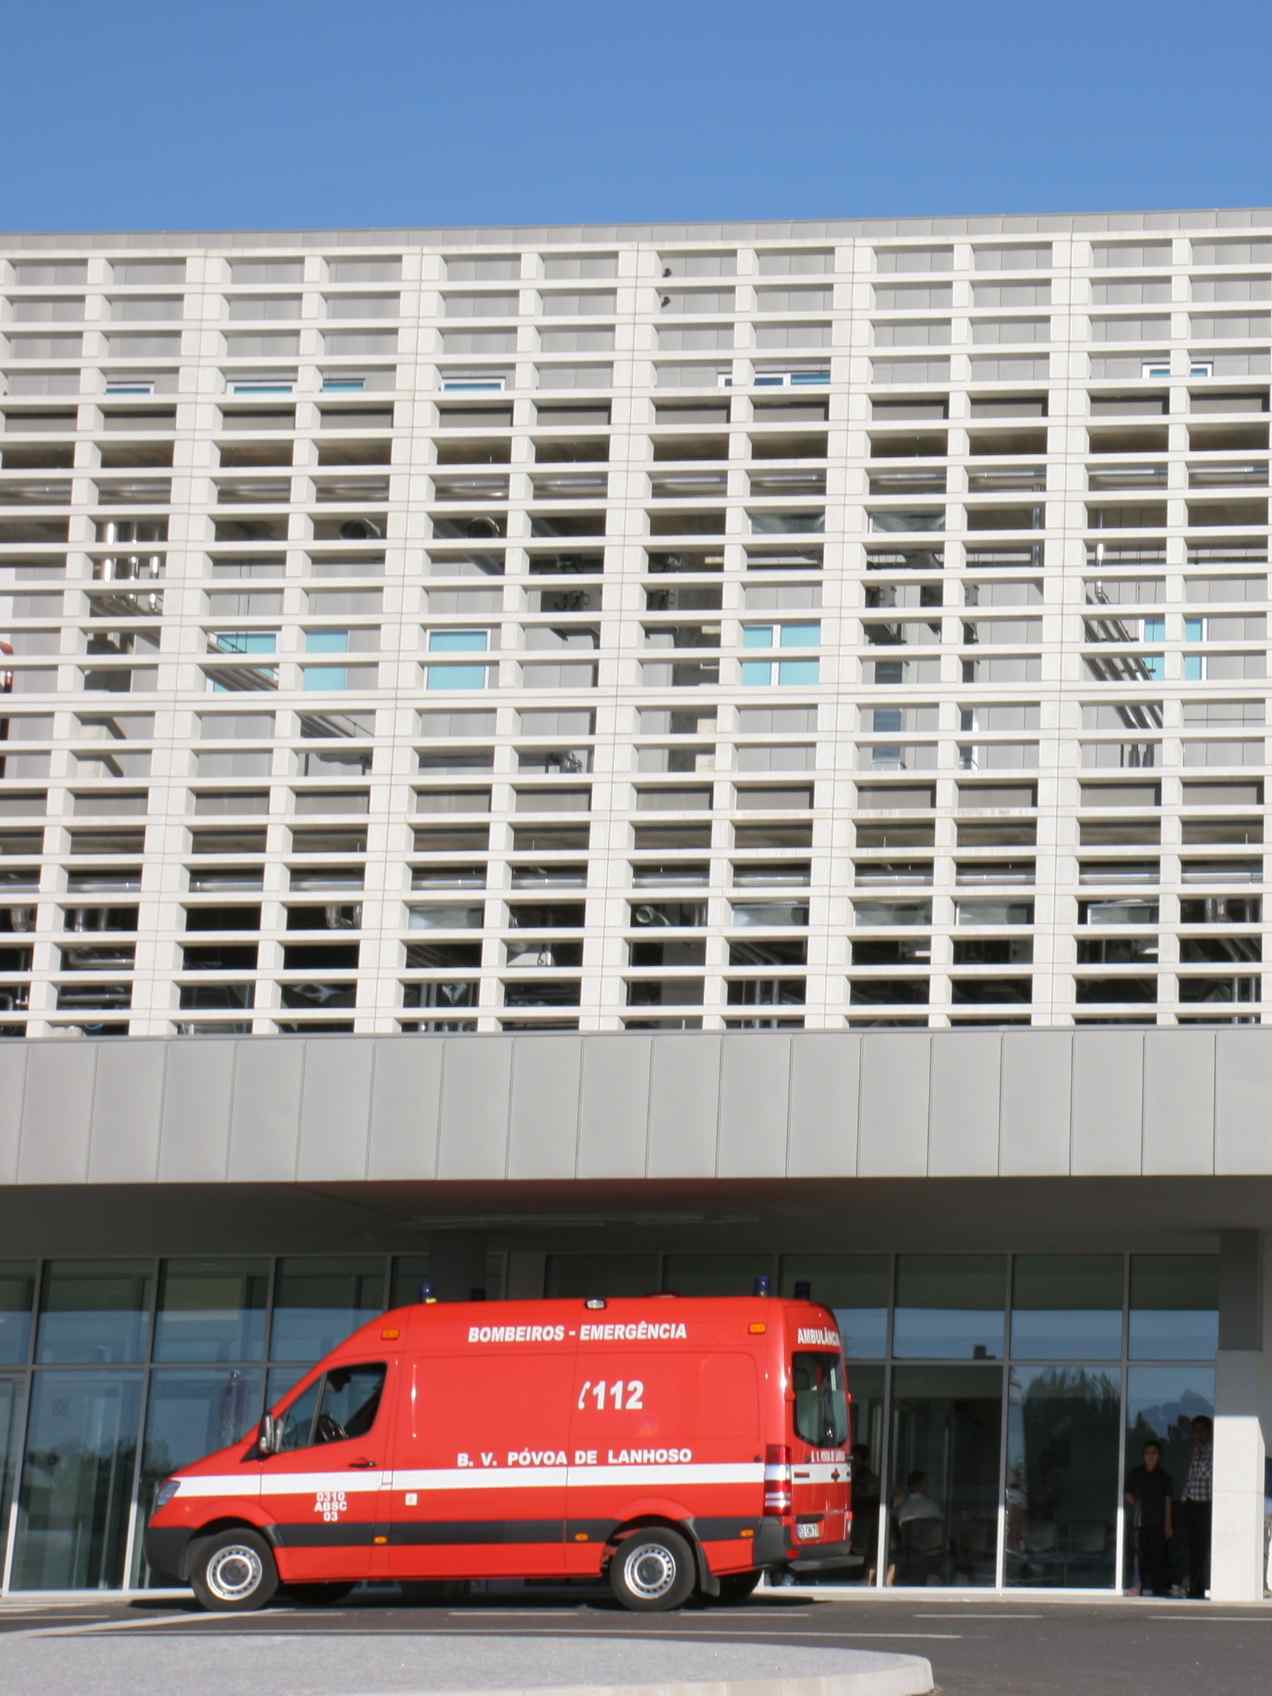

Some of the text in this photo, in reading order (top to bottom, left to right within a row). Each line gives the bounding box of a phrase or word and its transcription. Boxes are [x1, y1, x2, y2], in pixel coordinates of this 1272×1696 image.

[468, 1325, 565, 1342] BOMBEIROS
[579, 1321, 688, 1341] EMERGÊNCIA
[592, 1380, 645, 1410] 112
[457, 1448, 692, 1467] B. V. PÓVOA DE LANHOSO
[314, 1502, 348, 1512] ABSC
